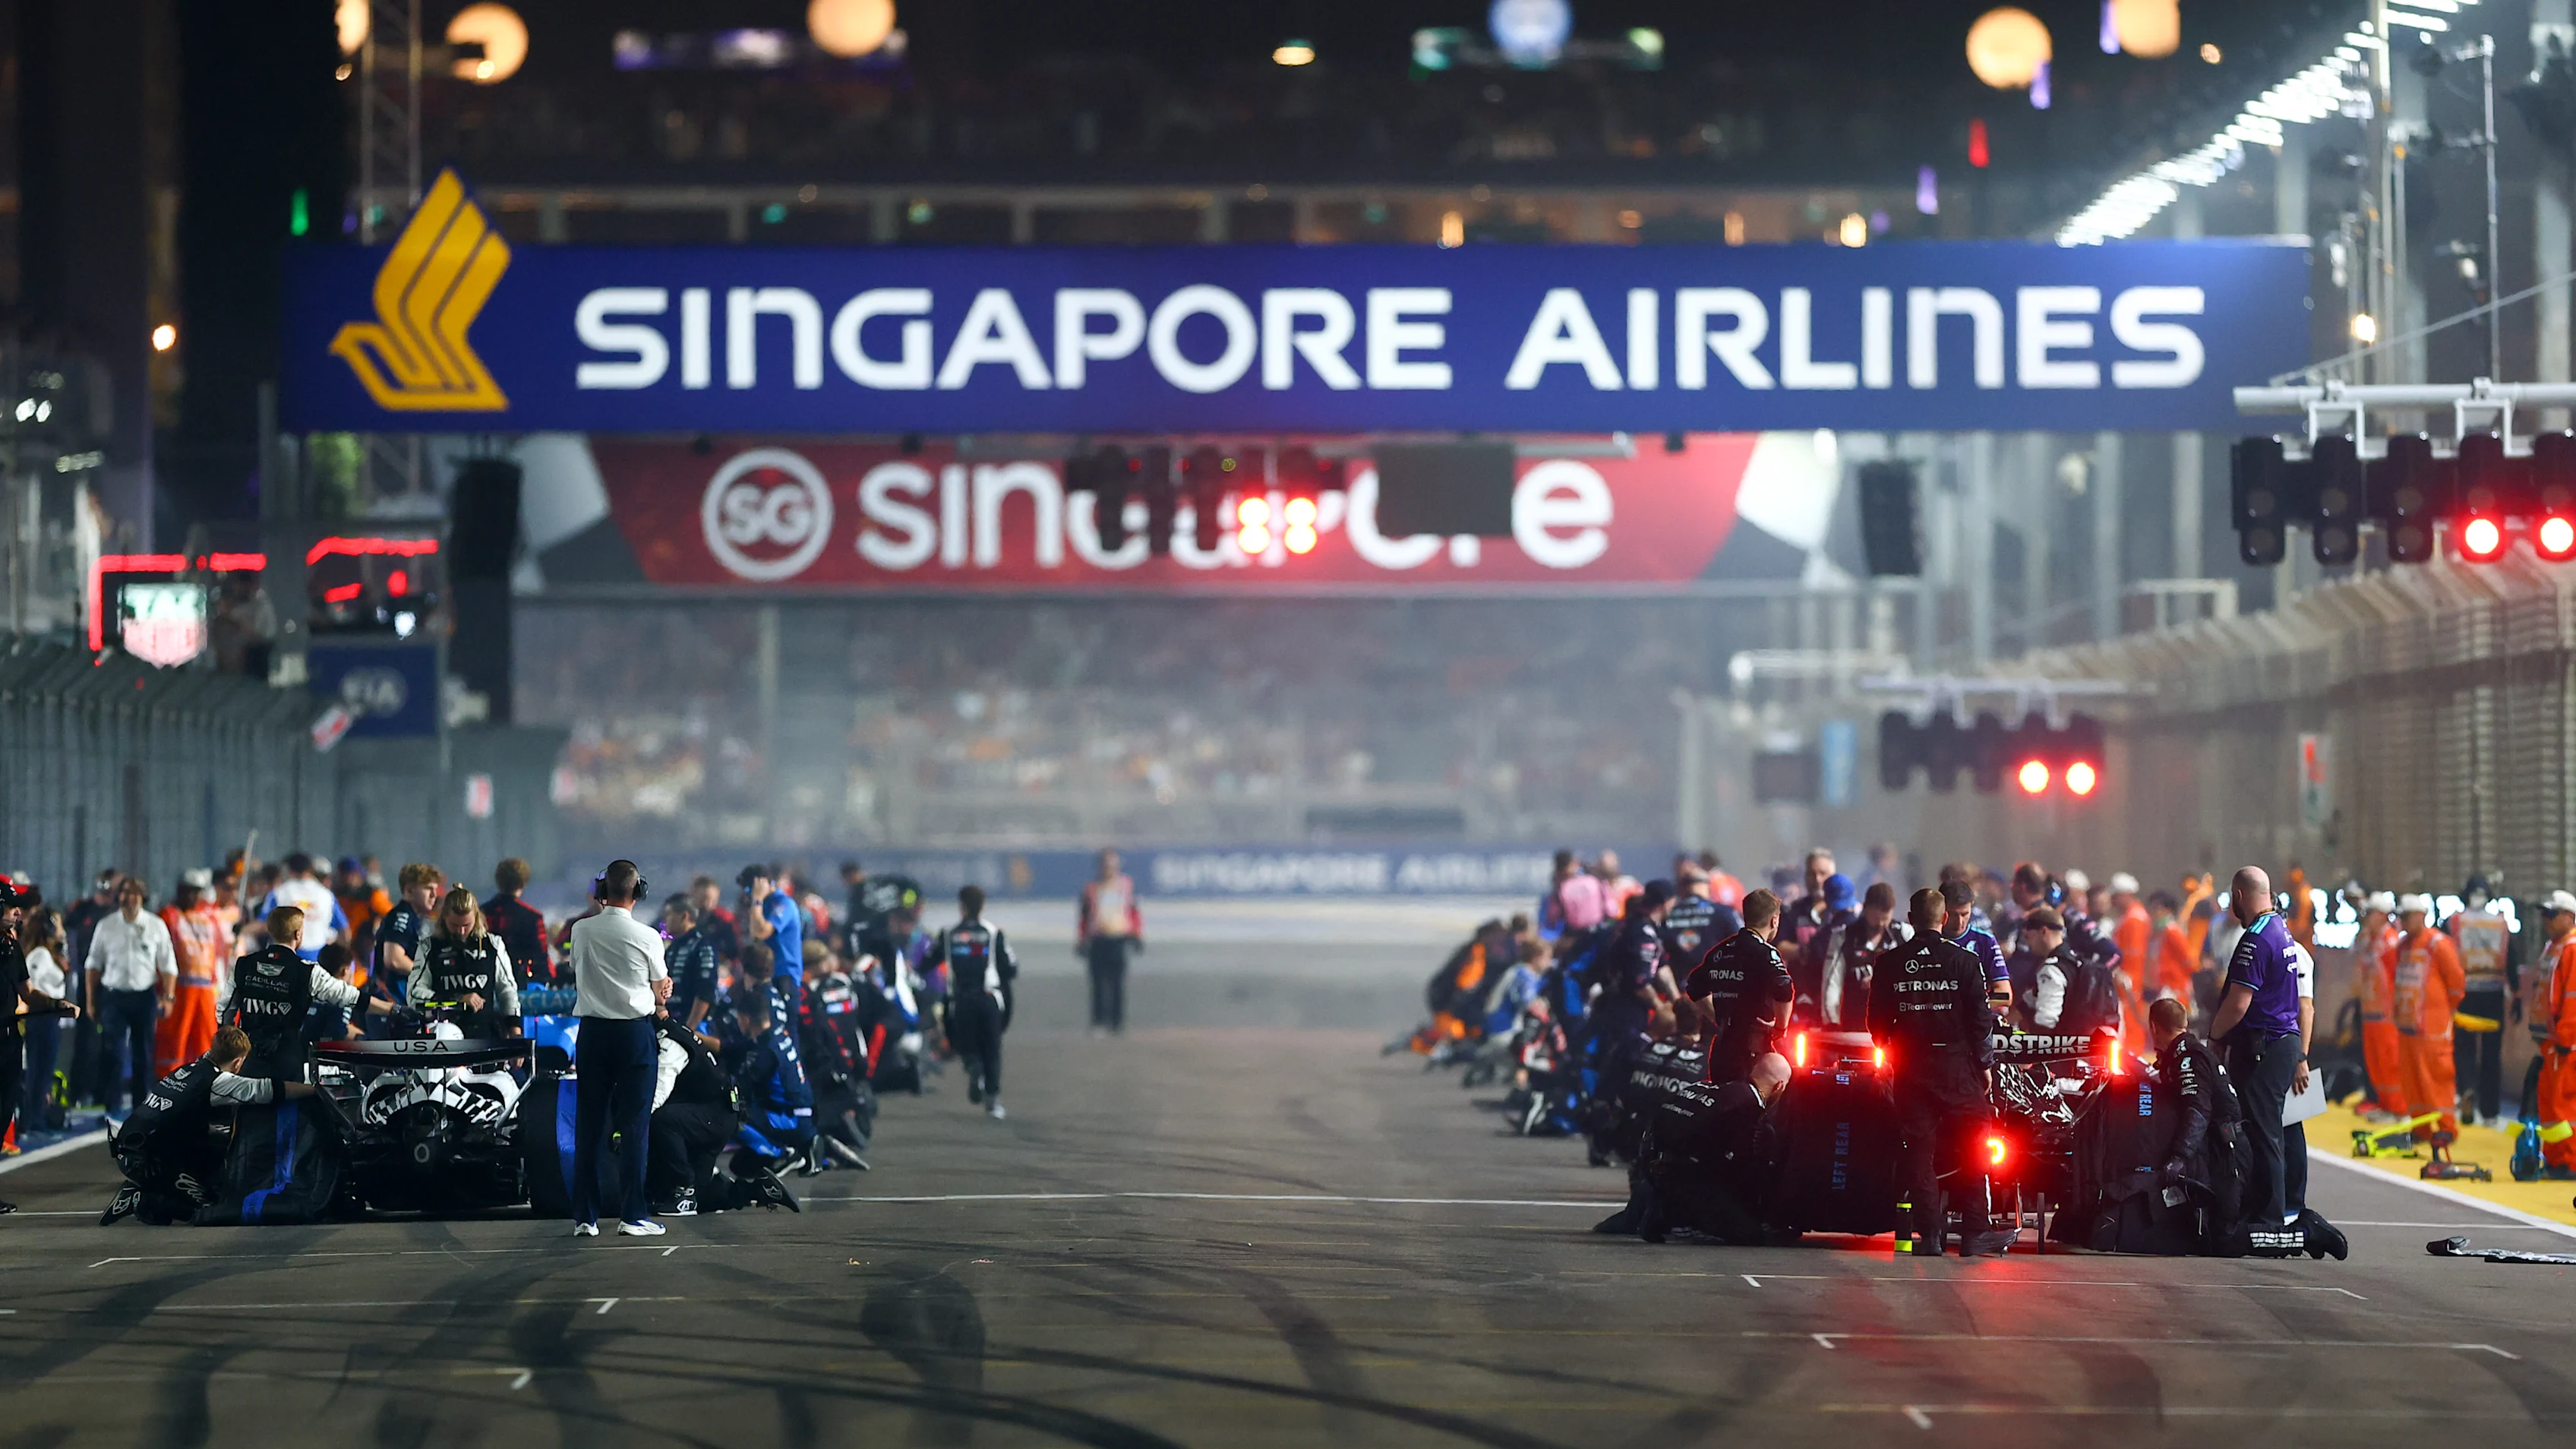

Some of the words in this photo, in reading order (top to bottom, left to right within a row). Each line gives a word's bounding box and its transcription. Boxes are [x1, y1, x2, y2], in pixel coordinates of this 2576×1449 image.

[576, 286, 1453, 393] SINGAPORE
[1504, 286, 2206, 391] AIRLINES
[724, 485, 813, 545] SG
[245, 975, 290, 987] CADILLAC
[1709, 970, 1744, 980] TRONAS
[1893, 980, 1959, 993] PETRONAS
[393, 1041, 449, 1053] USA
[1992, 1034, 2091, 1055] DSTRIKE
[2139, 1094, 2152, 1116] REAR
[1835, 1122, 1850, 1155] REAR
[1832, 1161, 1847, 1190] LEFT
